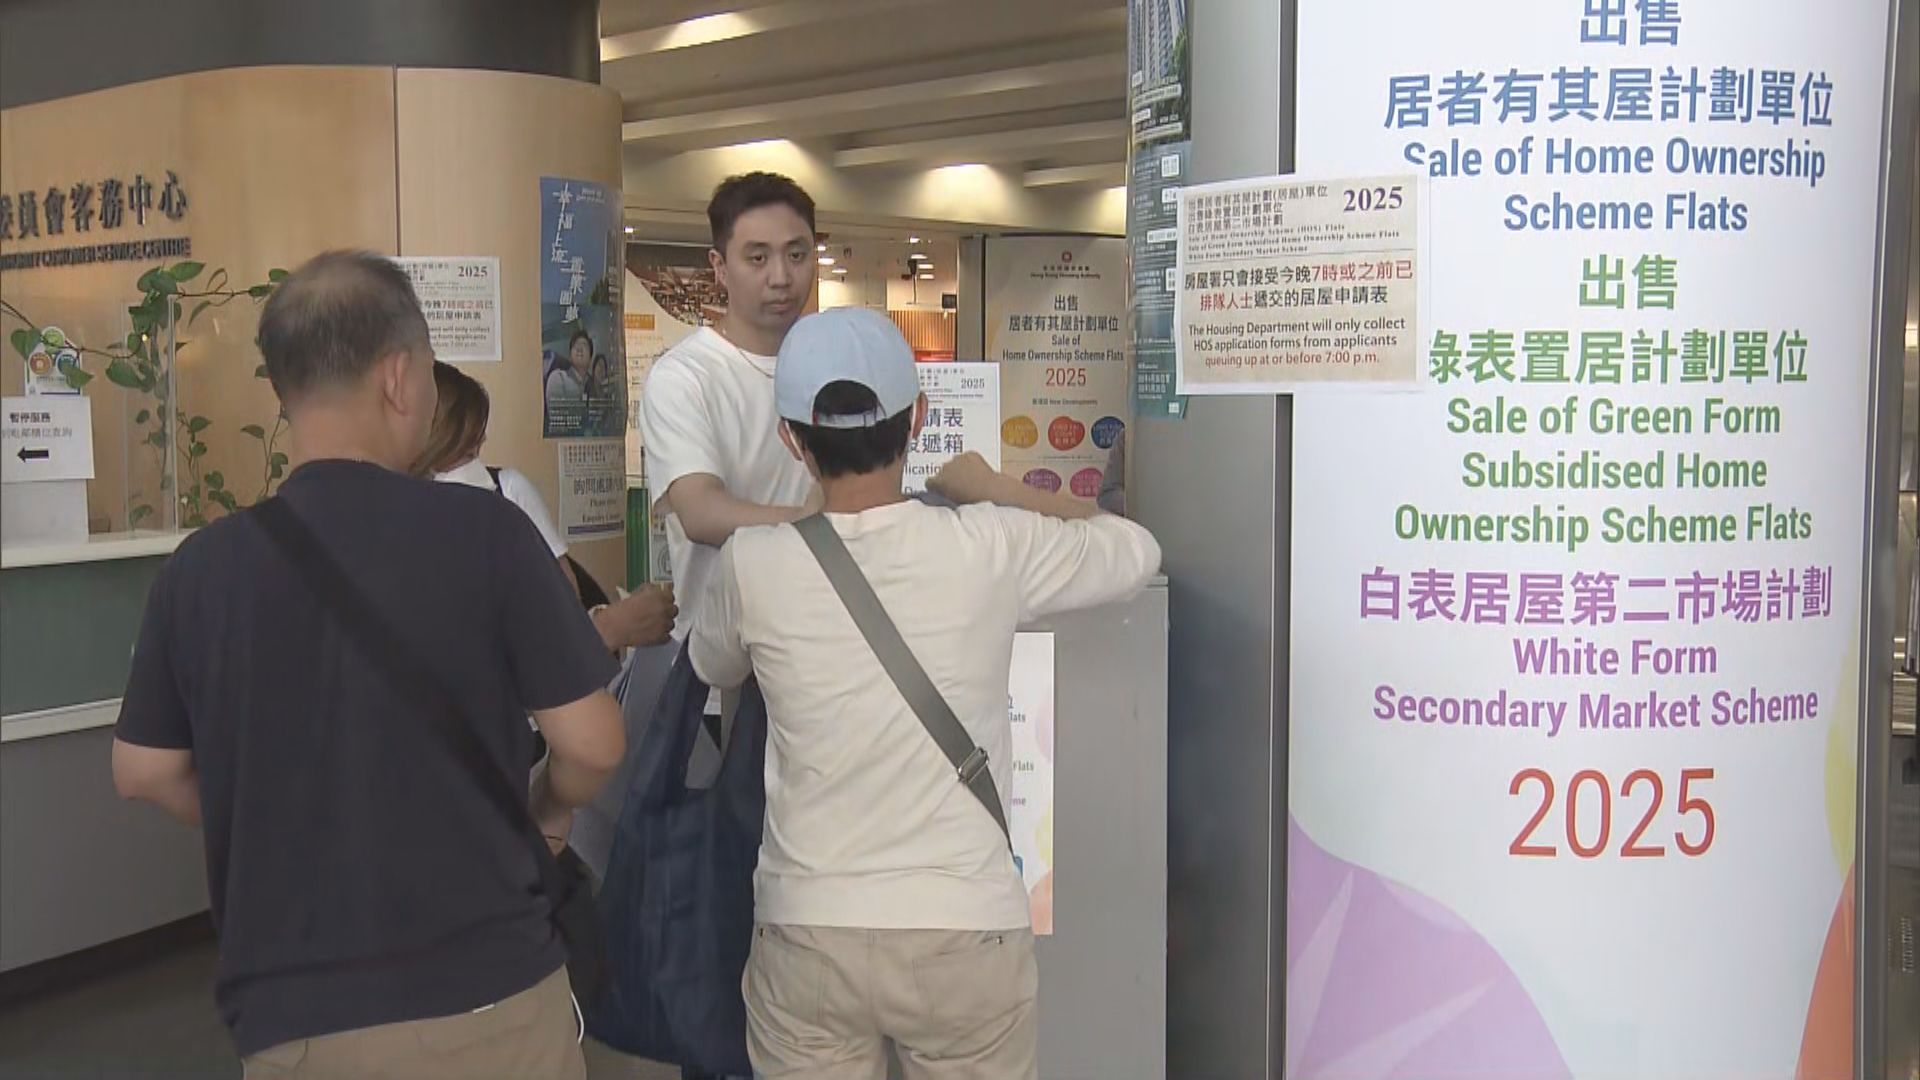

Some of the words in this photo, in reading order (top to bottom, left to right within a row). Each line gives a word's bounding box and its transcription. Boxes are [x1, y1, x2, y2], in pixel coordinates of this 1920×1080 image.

[1581, 0, 1682, 46] 出售
[1384, 66, 1834, 129] 居者有其屋計劃單位
[1404, 138, 1482, 177] Sale
[1494, 136, 1533, 175] of
[1545, 138, 1654, 175] Home
[1666, 137, 1826, 186] Ownership
[1343, 186, 1403, 211] 2025
[1503, 193, 1654, 231] Scheme
[1665, 194, 1748, 231] Flats
[97, 241, 142, 262] SERVICE
[143, 237, 191, 259] CENTRE
[458, 266, 488, 278] 2025
[1185, 259, 1413, 290] 房屋署只會接受今晚7時或之前已
[1578, 254, 1678, 310] 出售
[1054, 294, 1078, 311] 出售
[1200, 286, 1388, 312] 排隊人士遞交的居屋申請表
[1051, 334, 1070, 345] Sale
[1072, 334, 1081, 345] of
[1189, 324, 1204, 336] The
[1206, 323, 1244, 337] Housing
[1247, 321, 1309, 336] Department
[1312, 319, 1332, 331] will
[1334, 318, 1360, 333] only
[1363, 317, 1406, 331] collect
[1002, 349, 1026, 360] Home
[1028, 349, 1072, 363] Ownership
[1074, 349, 1105, 361] Scheme
[1106, 349, 1124, 361] Flats
[1194, 339, 1213, 351] HOS
[1214, 336, 1268, 353] application
[1270, 336, 1300, 349] forms
[1303, 335, 1331, 348] from
[1333, 333, 1398, 350] applicants
[1205, 353, 1242, 368] queuing
[1244, 355, 1257, 366] up
[1260, 353, 1270, 365] at
[1272, 354, 1283, 365] or
[1286, 352, 1322, 364] before
[1325, 351, 1350, 363] 7:00
[1353, 352, 1380, 366] p.m.
[961, 378, 985, 389] 2025
[1045, 367, 1087, 387] 2025
[1447, 396, 1527, 434] Sale
[1538, 396, 1577, 433] of
[1589, 397, 1690, 434] Green
[1703, 397, 1781, 434] Form
[1462, 451, 1664, 490] Subsidised
[1676, 452, 1768, 488] Home
[1395, 504, 1589, 552] Ownership
[1601, 507, 1737, 542] Scheme
[1747, 504, 1813, 540] Flats
[1360, 565, 1833, 626] 白表居屋第二市場計劃
[1512, 637, 1619, 675] White
[1631, 638, 1718, 675] Form
[1008, 712, 1026, 723] lats
[1373, 685, 1567, 737] Secondary
[1579, 690, 1701, 729] Market
[1710, 689, 1819, 726] Scheme
[1509, 767, 1716, 858] 2025
